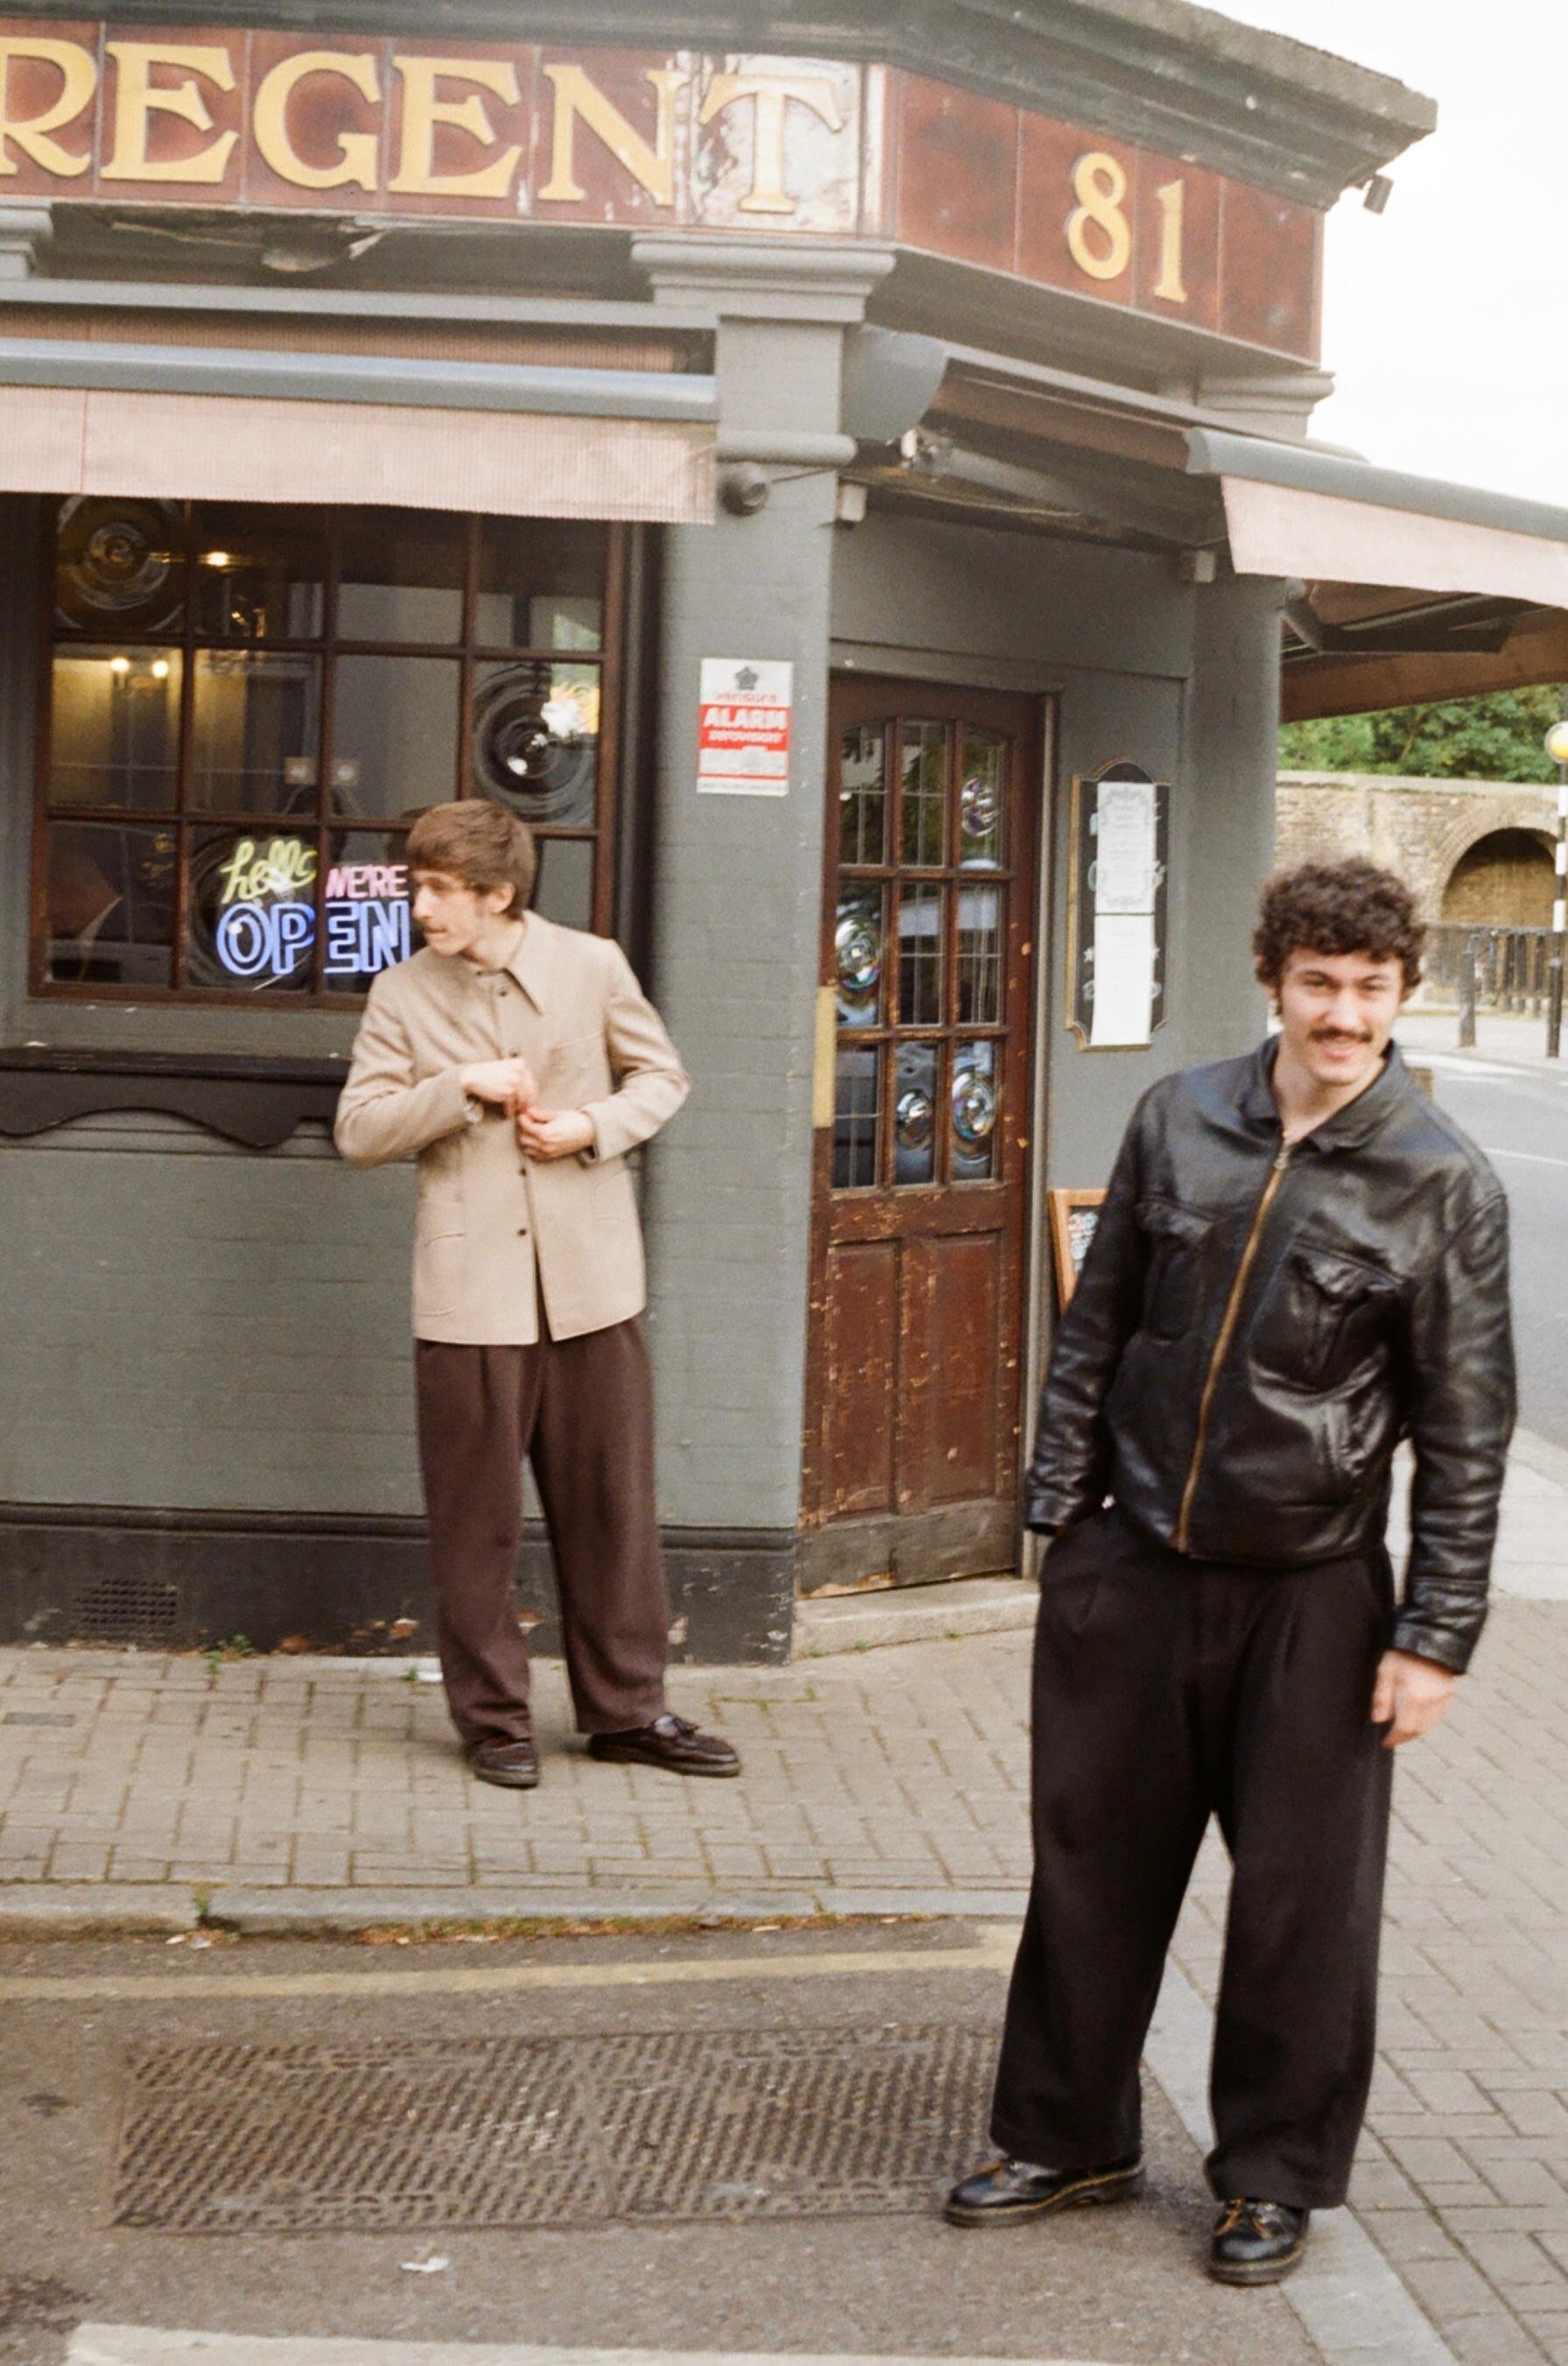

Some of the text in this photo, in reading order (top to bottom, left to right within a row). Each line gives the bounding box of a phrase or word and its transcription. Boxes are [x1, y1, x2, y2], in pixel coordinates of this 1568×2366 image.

[0, 37, 843, 215] REGENT
[1065, 151, 1188, 303] 81
[702, 707, 788, 730] ALARM
[216, 900, 411, 975] OPEN
